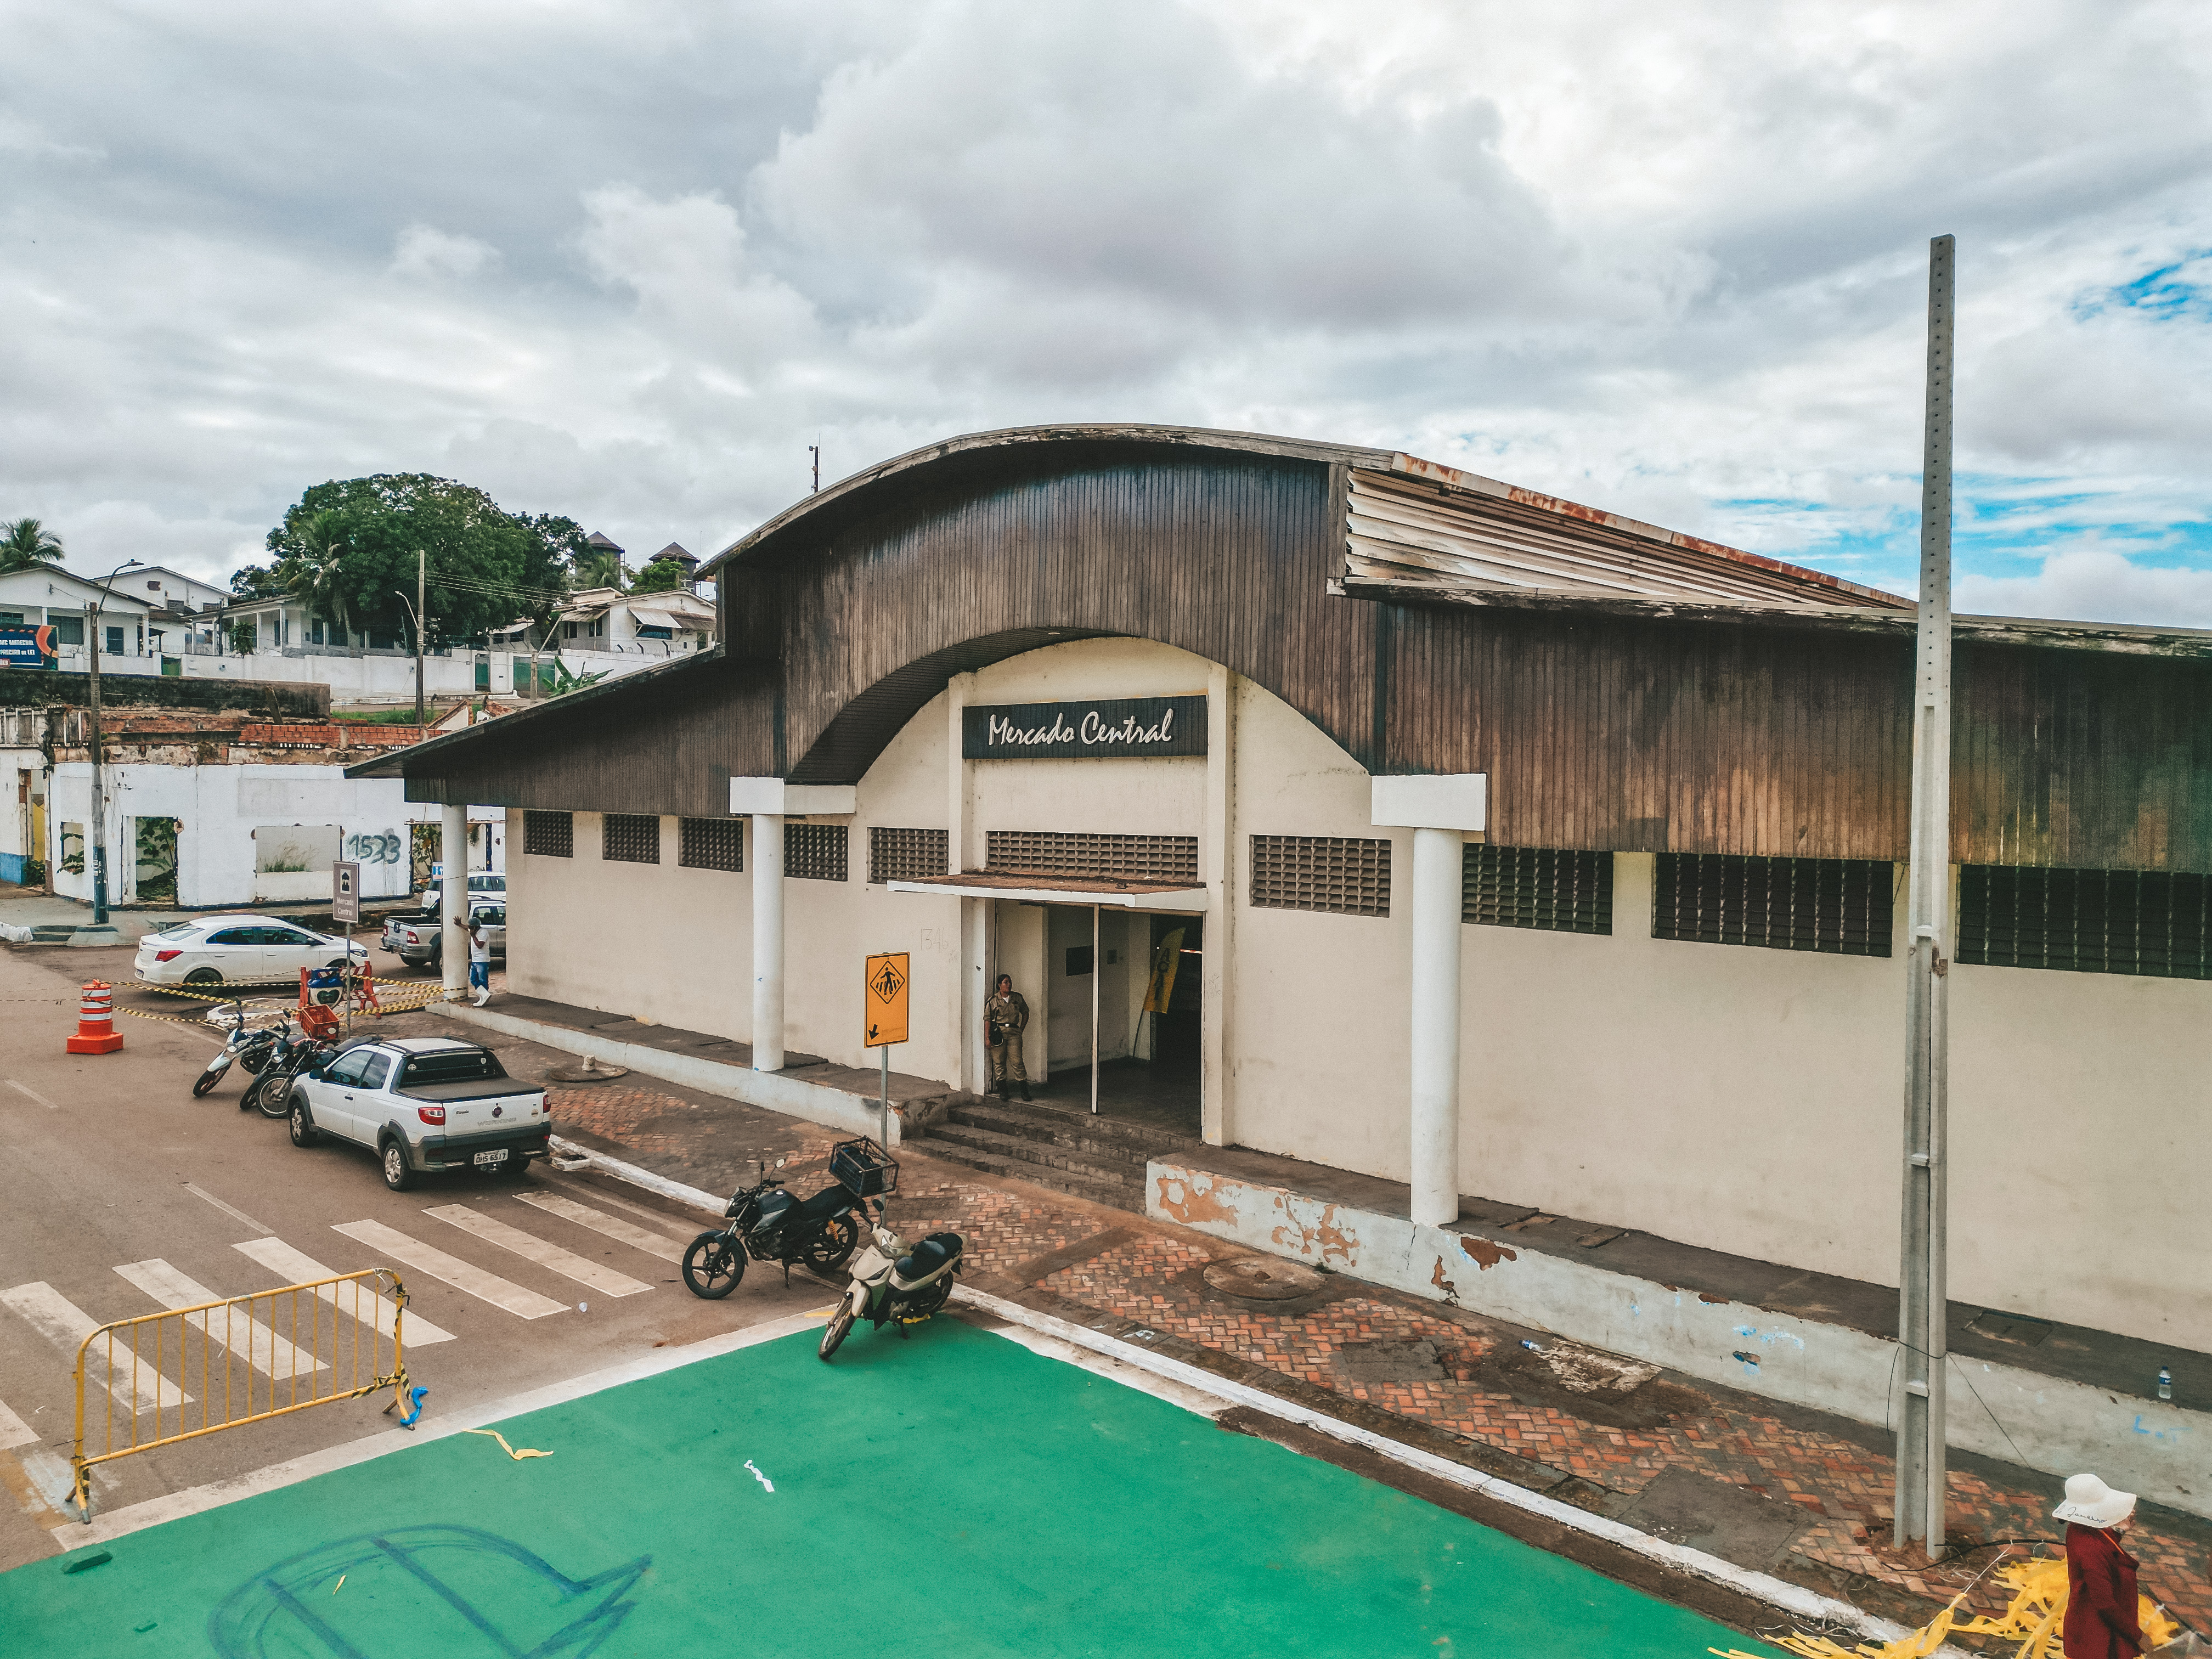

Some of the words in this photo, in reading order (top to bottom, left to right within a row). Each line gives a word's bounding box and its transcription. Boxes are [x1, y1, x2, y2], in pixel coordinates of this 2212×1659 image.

[989, 713, 1074, 746] Mercado
[1080, 708, 1174, 745] Central
[337, 896, 354, 906] Mercado
[337, 907, 353, 916] Central
[477, 1117, 517, 1127] WORKING
[490, 1153, 506, 1161] 6517
[2067, 1506, 2108, 1523] Janeiro
